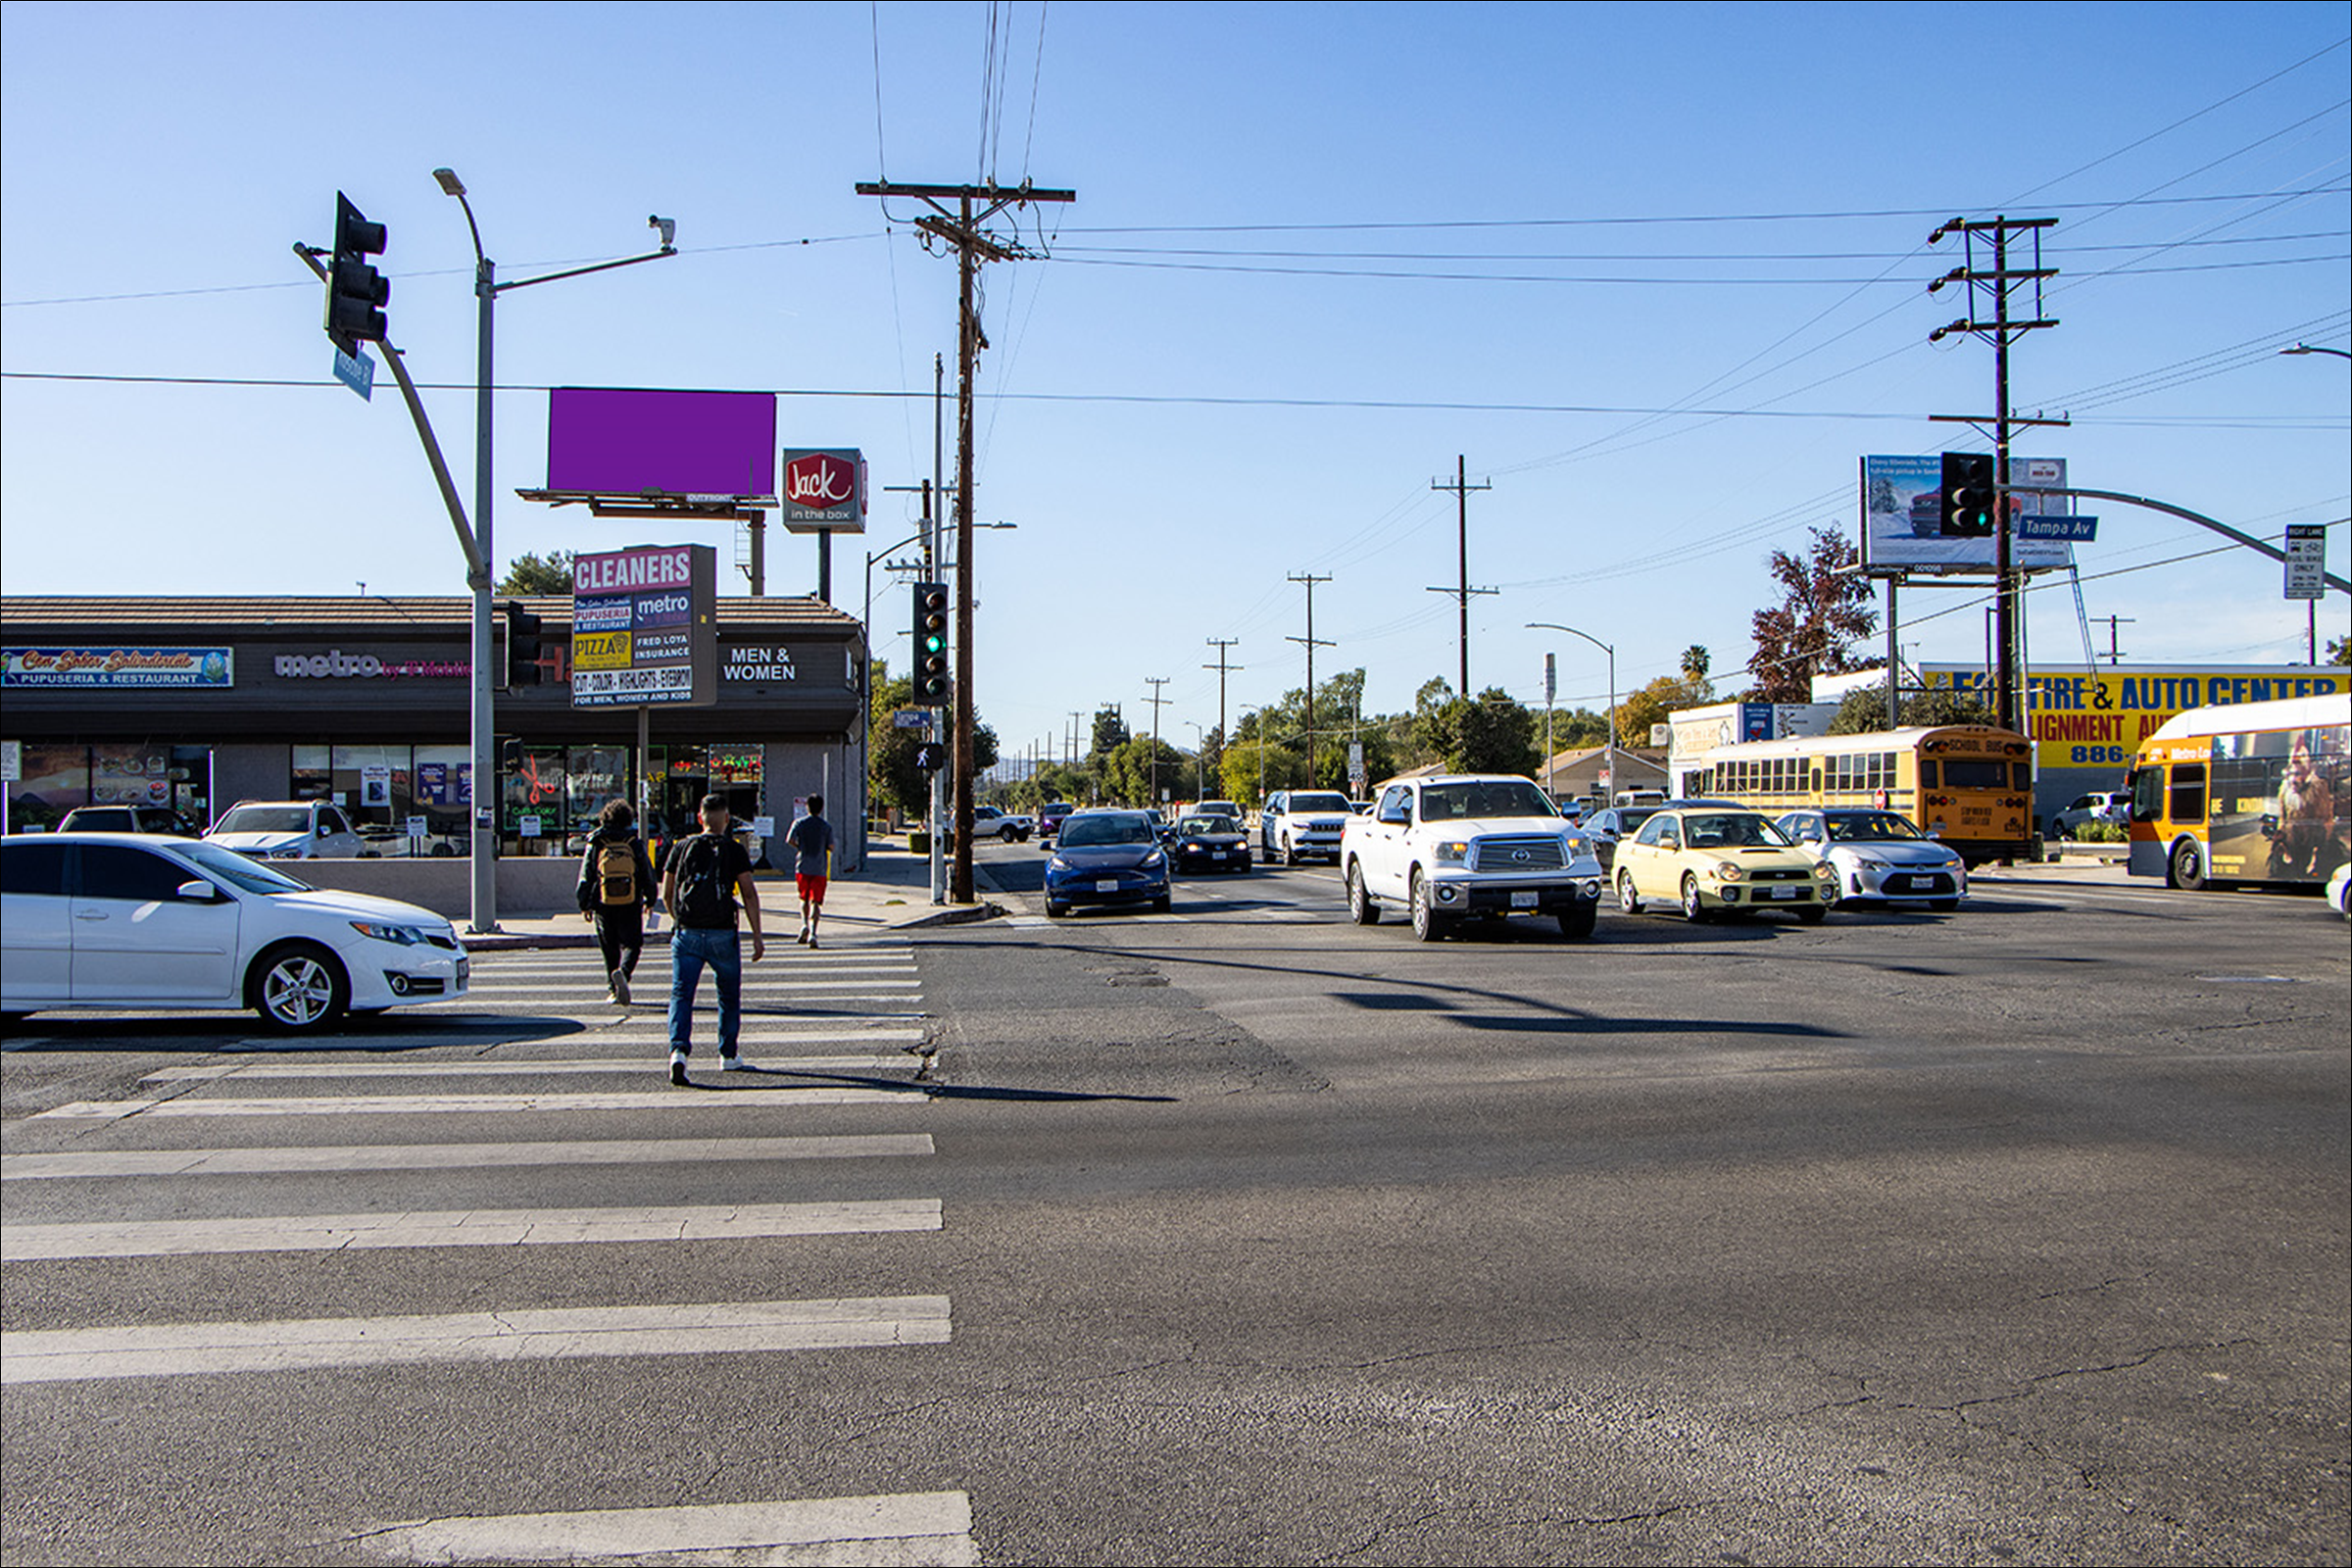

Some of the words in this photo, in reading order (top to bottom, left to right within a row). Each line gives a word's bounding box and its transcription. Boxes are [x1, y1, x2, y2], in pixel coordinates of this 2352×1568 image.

[788, 460, 852, 500] Jack
[792, 510, 803, 519] in
[805, 510, 825, 519] the
[827, 510, 851, 519] box
[2026, 520, 2069, 536] Tampa
[2072, 522, 2090, 534] Av
[575, 552, 690, 590] CLEANERS
[638, 595, 689, 614] metro
[574, 608, 630, 620] PUPUSERIA
[582, 620, 631, 629] RESTAURANT
[575, 639, 615, 657] PIZZA
[637, 636, 662, 647] FRED
[663, 635, 688, 645] LOYA
[22, 650, 56, 670] Con
[55, 650, 105, 672] Sabor
[635, 647, 690, 660] INSURANCE
[731, 648, 771, 663] MEN
[776, 648, 790, 663] &
[274, 649, 380, 678] metro
[381, 661, 402, 681] by
[723, 665, 795, 680] WOMEN
[22, 674, 96, 683] PUPUSERIA
[99, 674, 108, 683] &
[113, 674, 197, 683] RESTAURANT
[574, 696, 592, 705] FOR
[615, 693, 649, 703] WOMEN
[650, 692, 669, 702] AND
[670, 691, 692, 701] KIDS
[2027, 677, 2086, 710] TIRE
[2092, 682, 2114, 710] &
[2120, 677, 2200, 710] AUTO
[1949, 739, 1982, 752] SCHOOL
[1985, 740, 2003, 753] BUS
[2171, 747, 2197, 760] Metro
